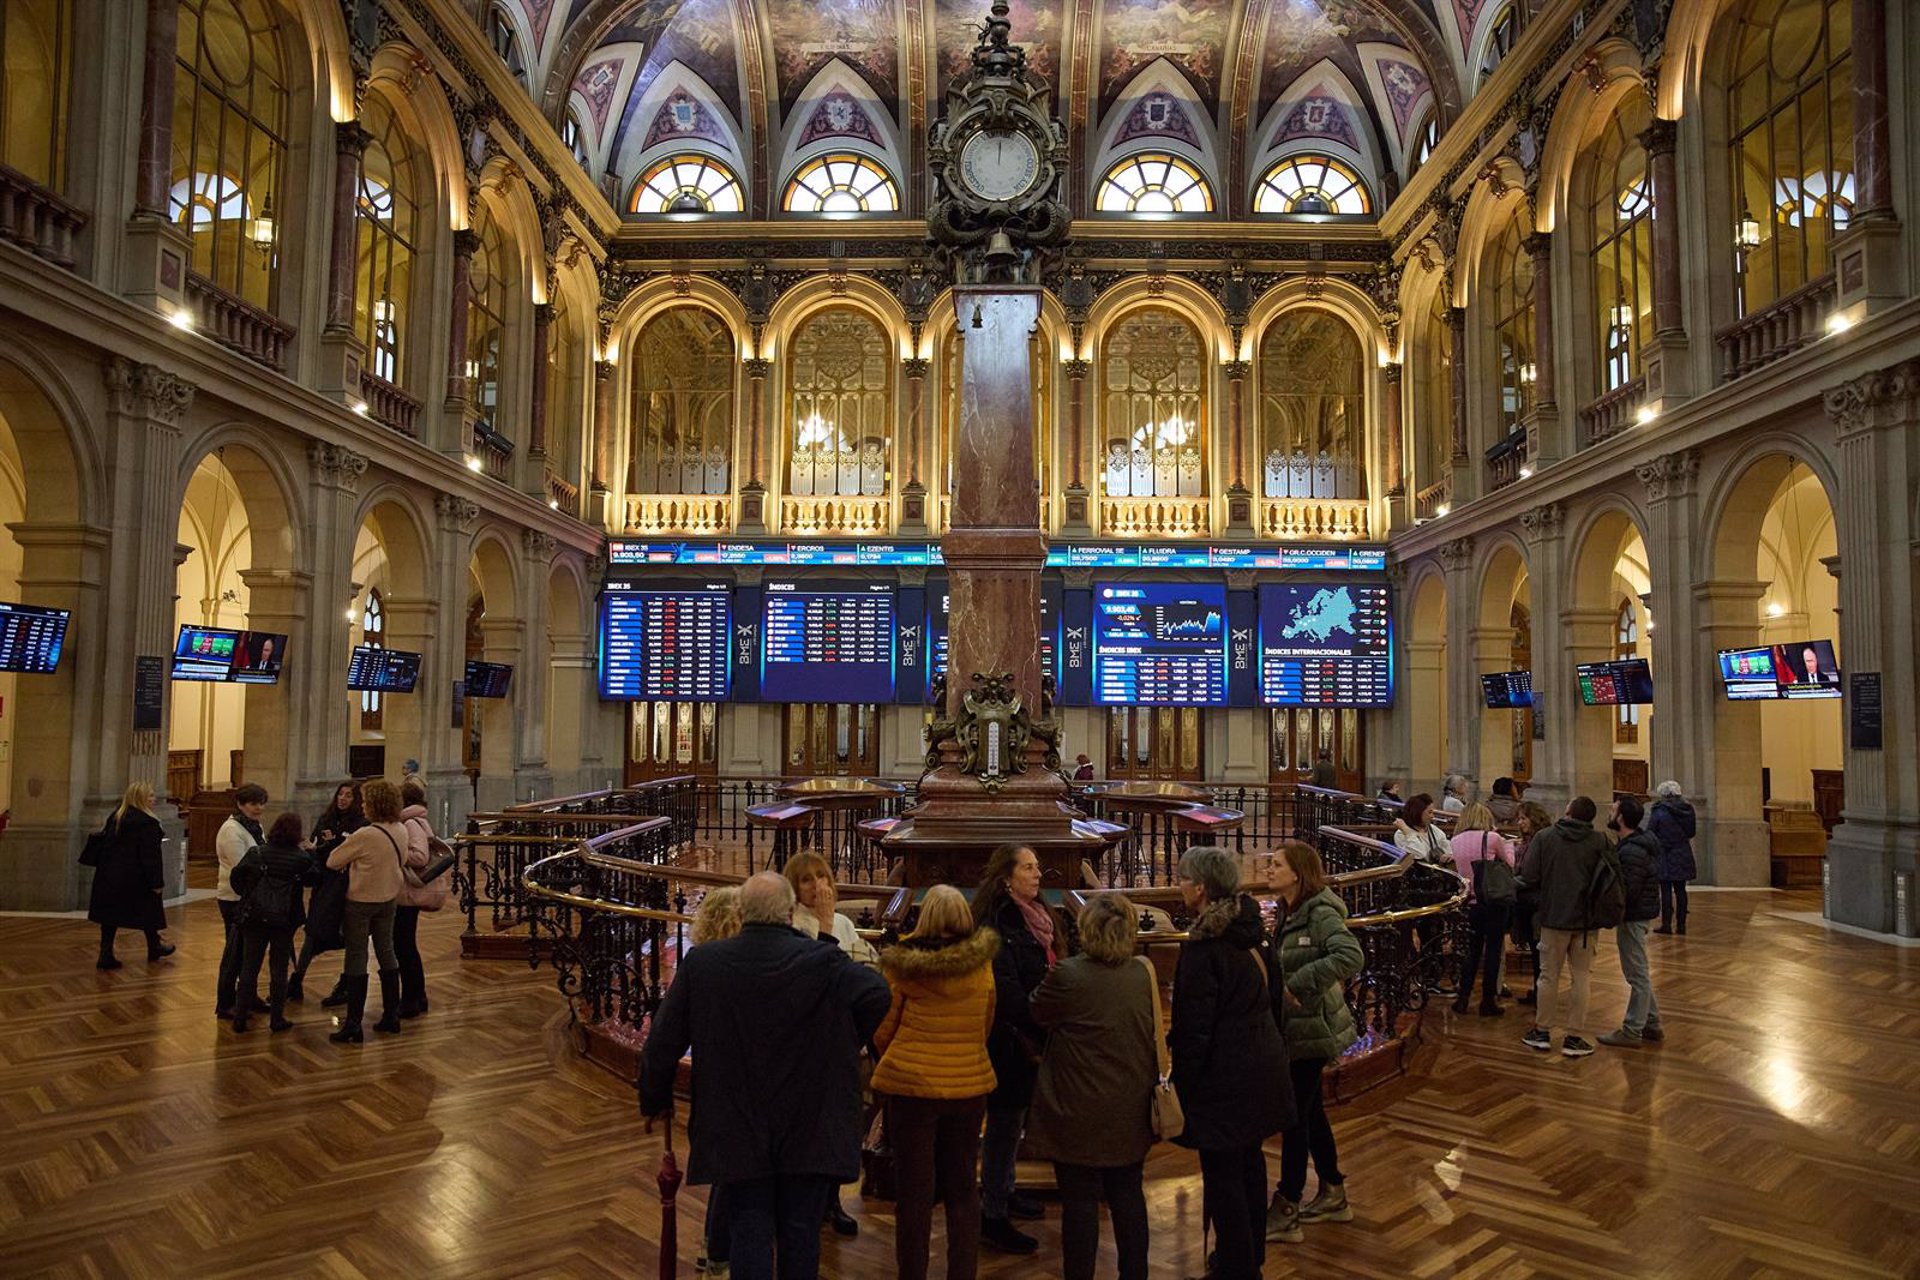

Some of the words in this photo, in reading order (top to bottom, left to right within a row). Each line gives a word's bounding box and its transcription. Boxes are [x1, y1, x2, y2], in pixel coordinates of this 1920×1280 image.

[739, 638, 750, 664] BME
[903, 640, 913, 666] BME
[1069, 642, 1080, 668] BME
[1235, 643, 1245, 669] BME
[1265, 647, 1291, 655] ÍNDICES
